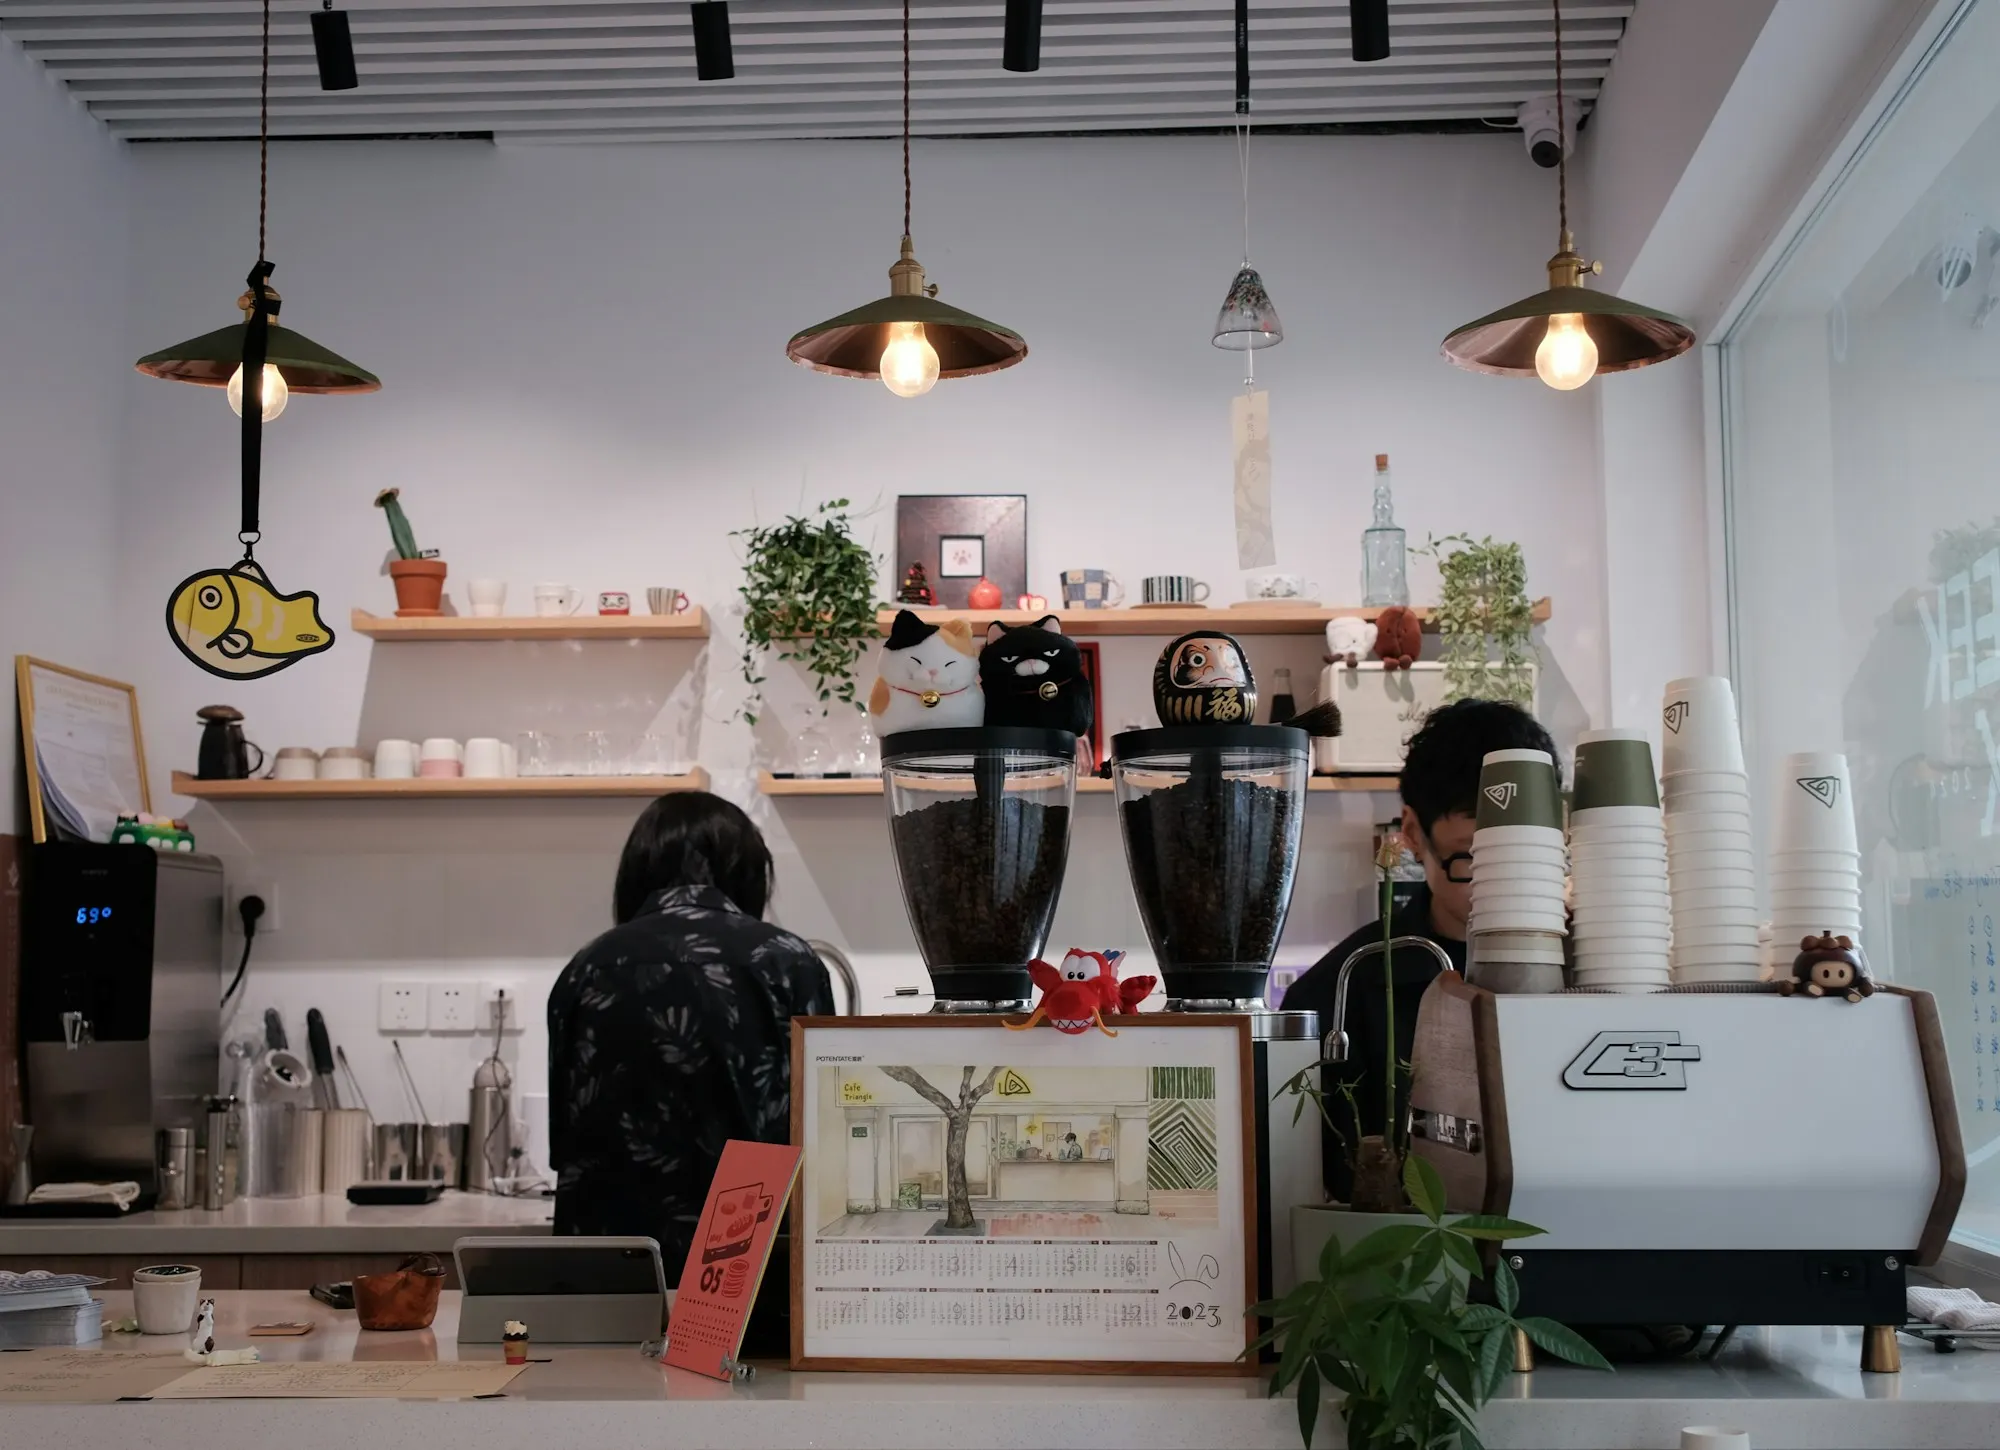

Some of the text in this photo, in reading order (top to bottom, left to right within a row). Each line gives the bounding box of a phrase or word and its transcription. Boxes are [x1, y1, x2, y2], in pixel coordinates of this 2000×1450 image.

[1205, 687, 1242, 722] 福
[844, 1083, 861, 1092] Cafe
[844, 1093, 872, 1102] Triangle
[700, 1264, 725, 1294] 05
[1166, 1302, 1222, 1328] 2023
